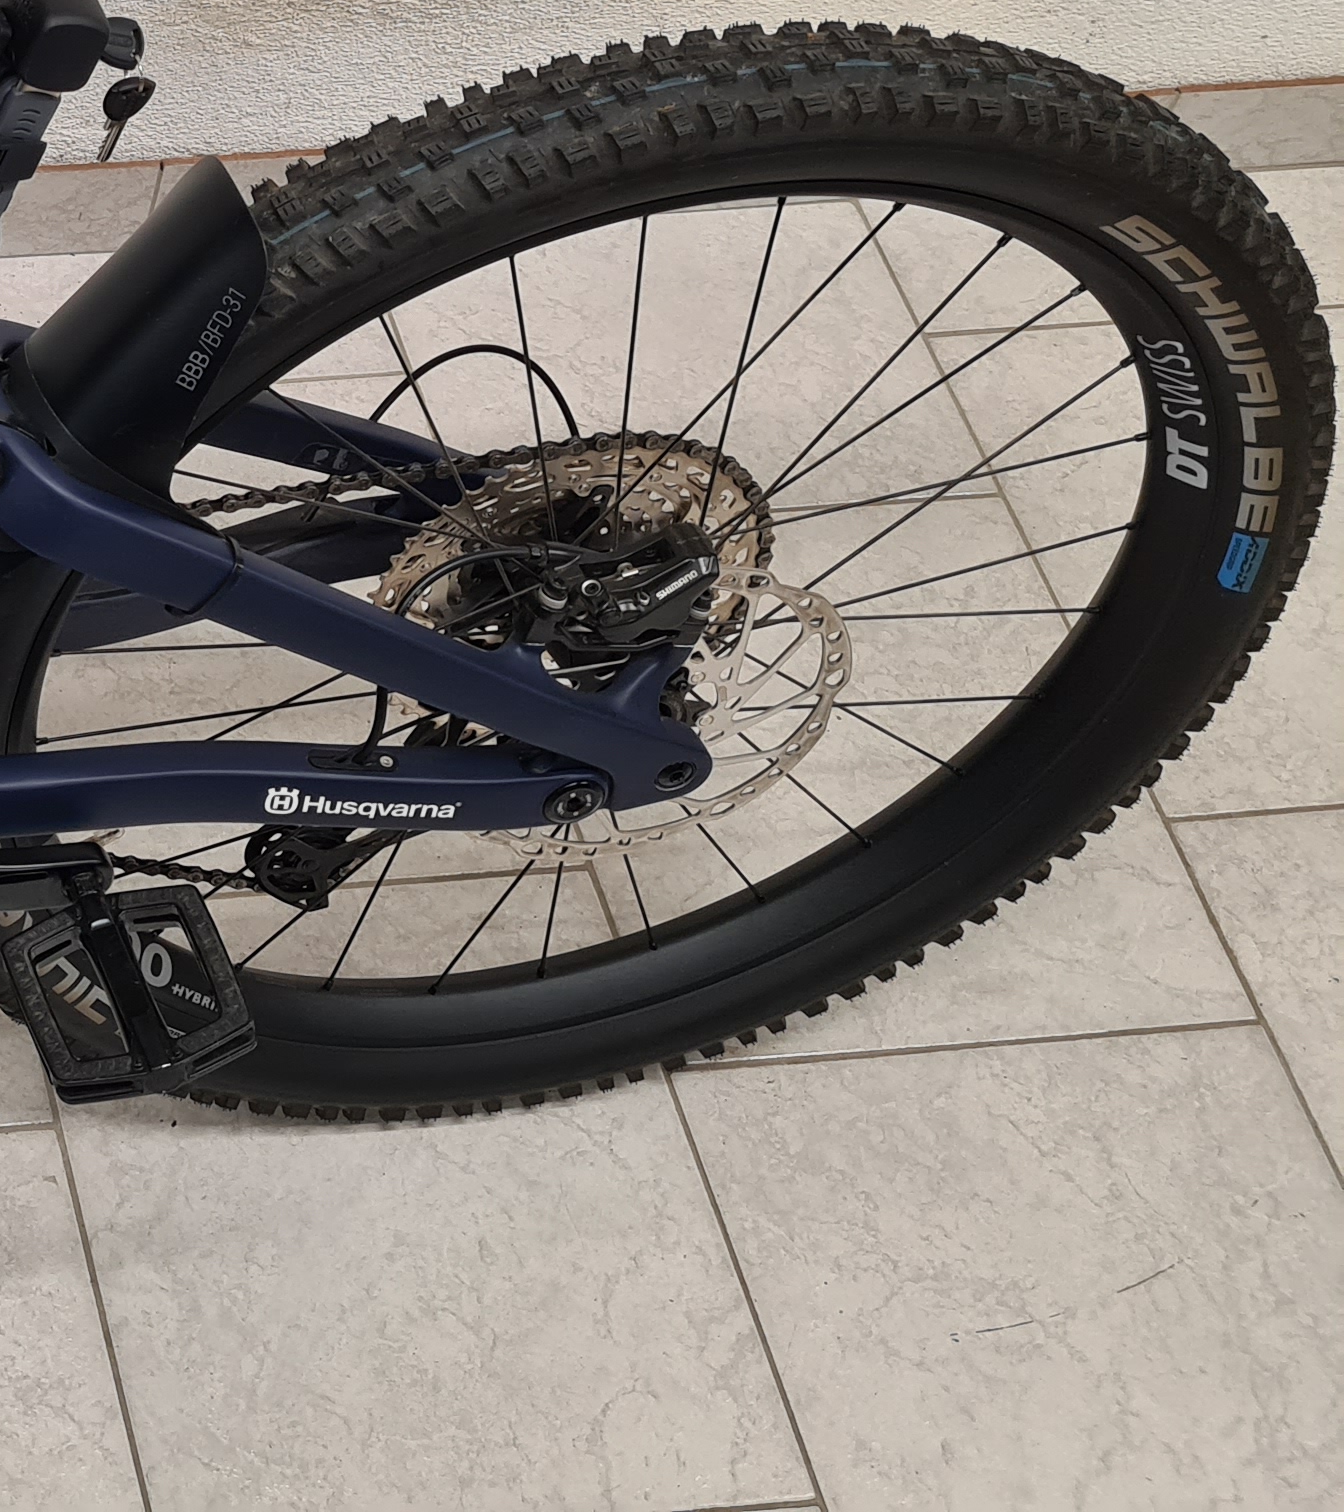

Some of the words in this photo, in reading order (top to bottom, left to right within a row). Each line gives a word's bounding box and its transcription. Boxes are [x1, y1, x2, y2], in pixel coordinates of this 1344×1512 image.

[175, 287, 247, 392] BBB/BFD-31
[1099, 214, 1284, 534] SCHWALBE
[1136, 334, 1207, 427] SWISS
[1164, 425, 1209, 490] DT
[655, 569, 699, 601] SHIMANO
[302, 795, 456, 820] Husqvarna
